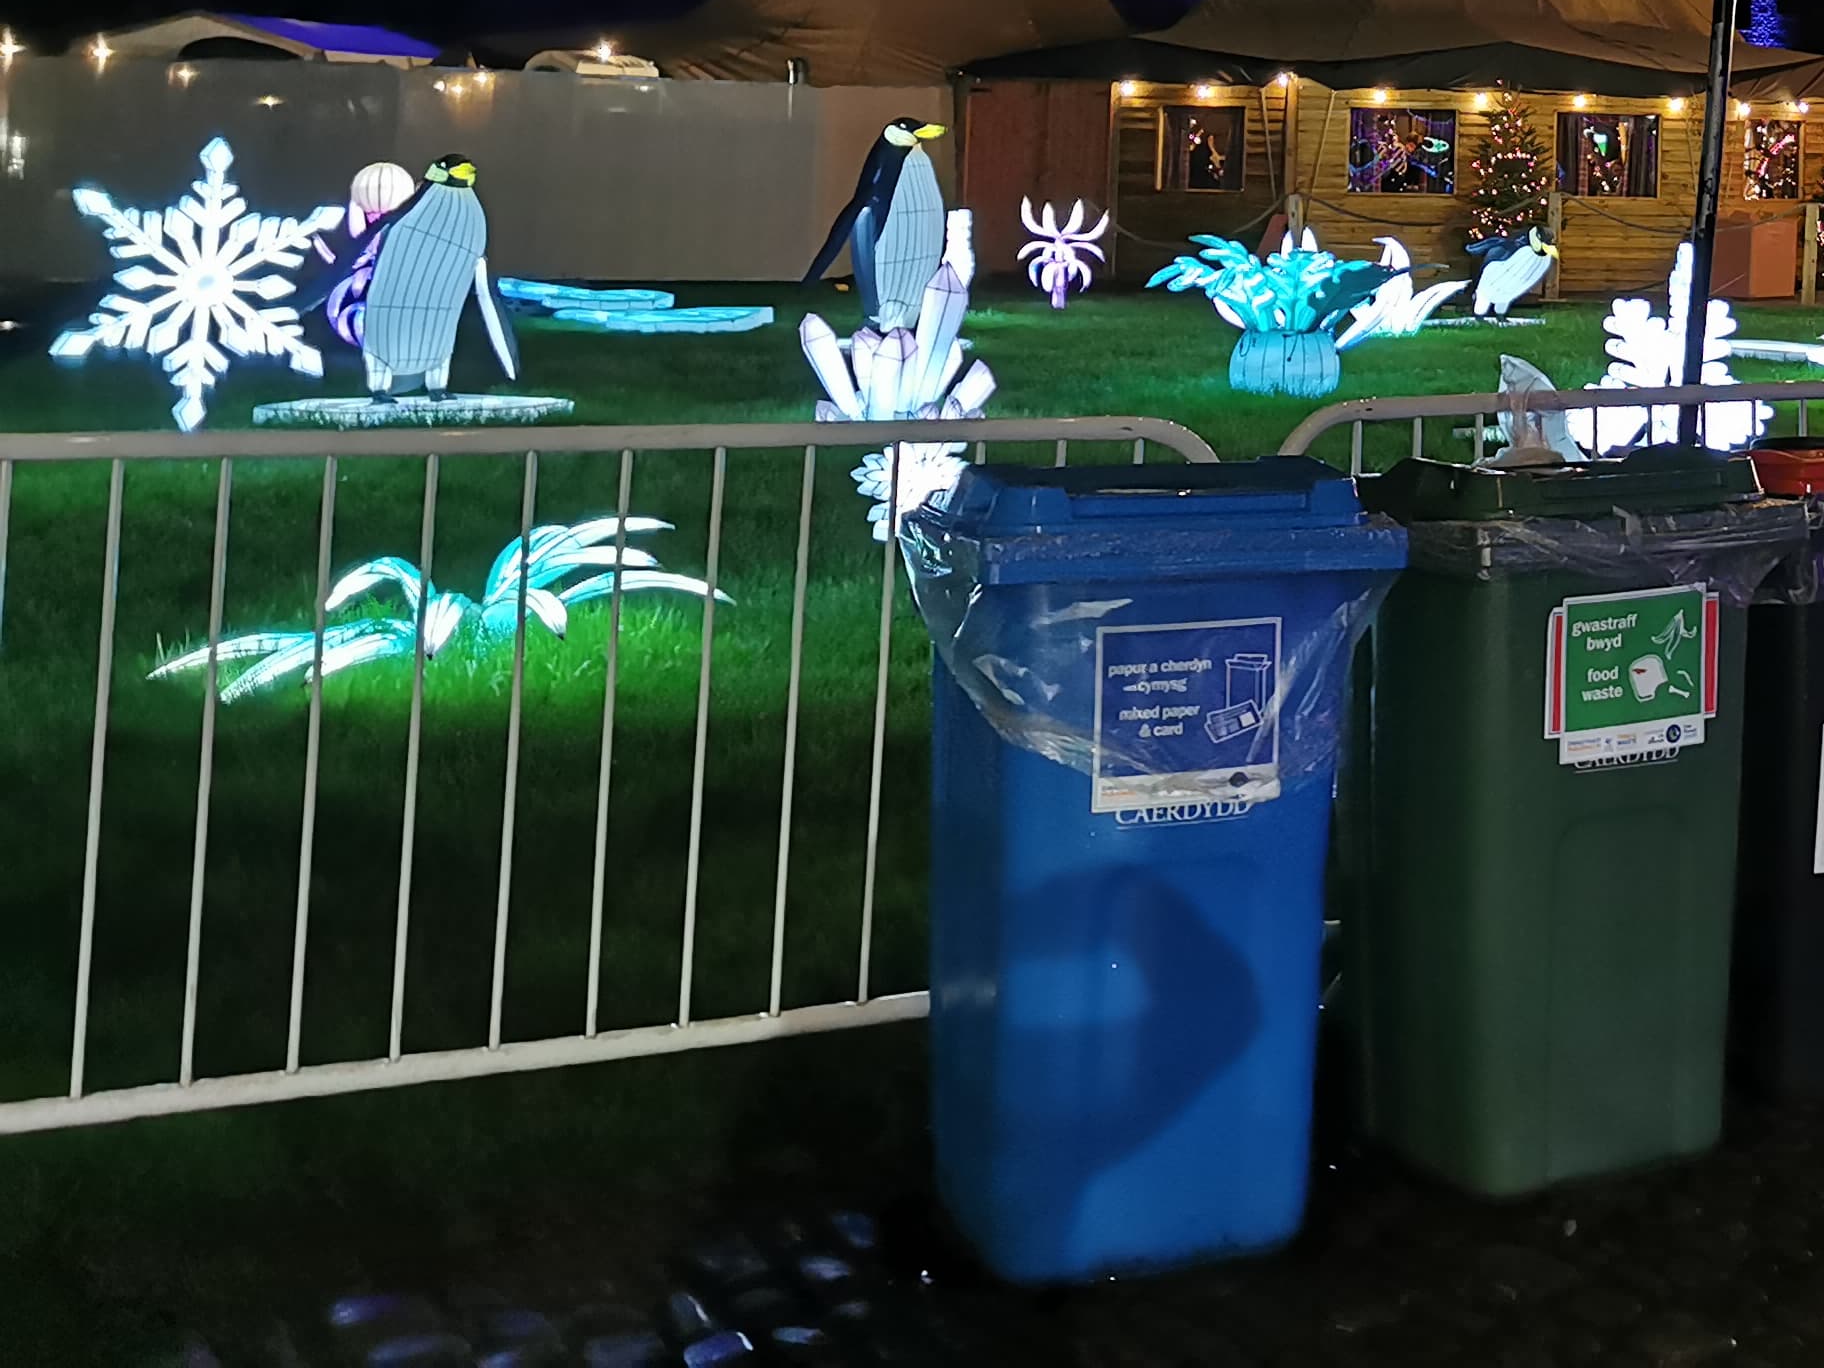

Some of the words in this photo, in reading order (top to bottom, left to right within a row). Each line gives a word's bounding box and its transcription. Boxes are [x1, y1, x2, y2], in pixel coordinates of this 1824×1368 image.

[1572, 613, 1638, 637] gwastraff
[1586, 633, 1622, 652] bwyd
[1107, 663, 1147, 679] papur
[1587, 666, 1619, 683] food
[1581, 685, 1624, 702] waste
[1119, 705, 1160, 721] mixed
[1161, 705, 1201, 721] paper
[1153, 721, 1184, 737] card
[1115, 799, 1252, 825] CAERDYDD
